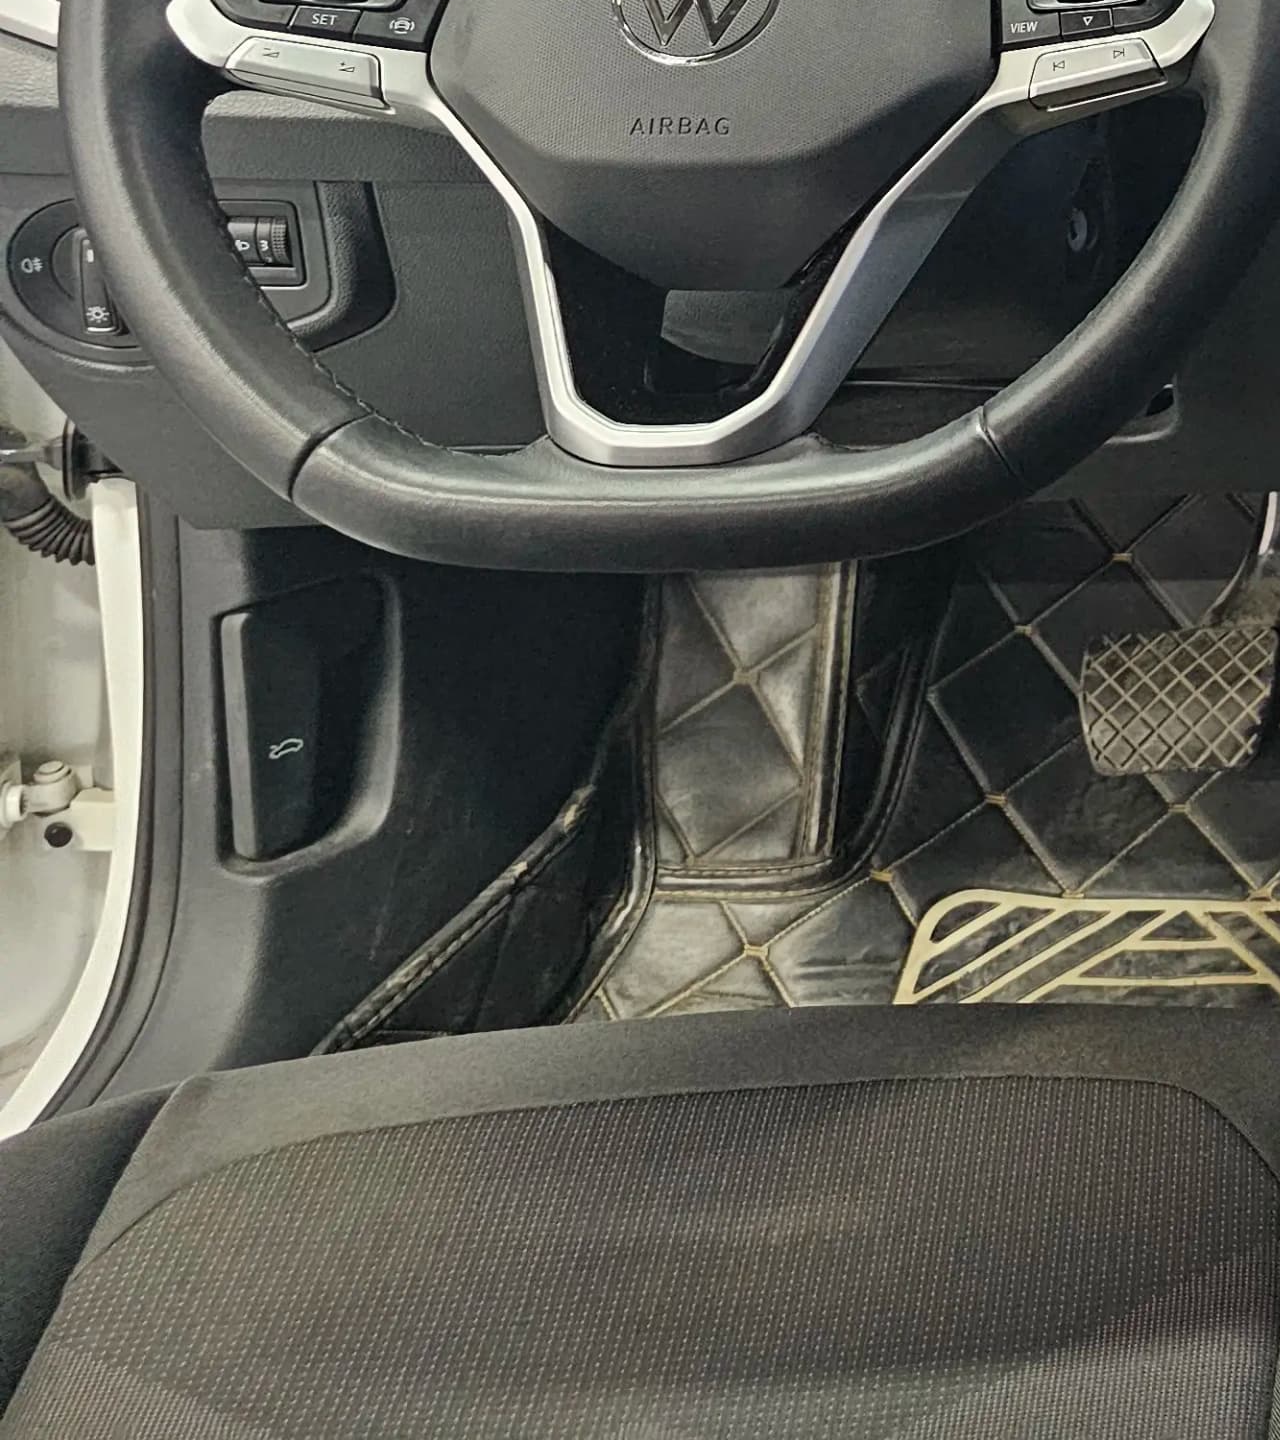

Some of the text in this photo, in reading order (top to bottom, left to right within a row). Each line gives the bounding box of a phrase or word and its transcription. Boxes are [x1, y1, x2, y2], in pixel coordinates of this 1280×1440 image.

[312, 13, 338, 26] SET
[1010, 21, 1038, 34] VIEW
[629, 116, 730, 136] AIRBAG
